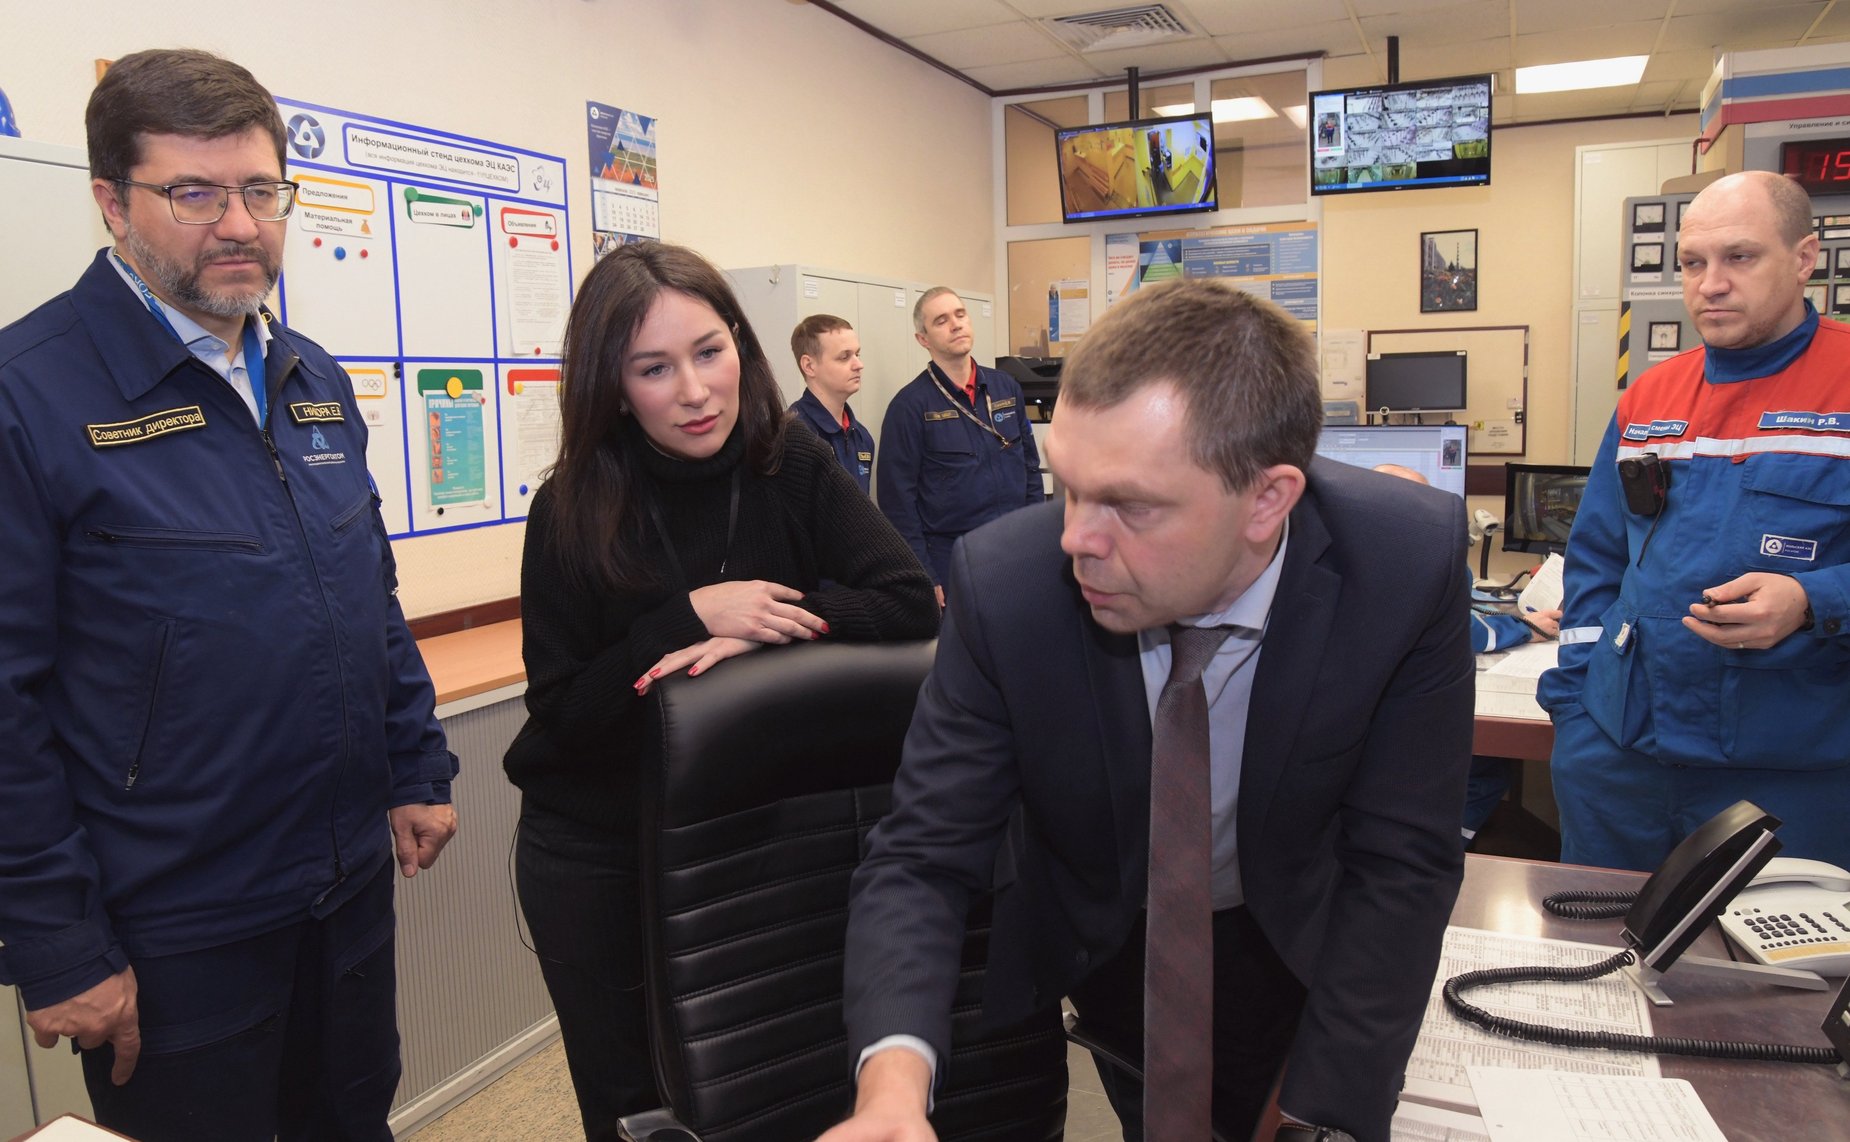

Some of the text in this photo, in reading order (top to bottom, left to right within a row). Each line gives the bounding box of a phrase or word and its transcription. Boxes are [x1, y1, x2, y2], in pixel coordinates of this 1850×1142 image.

[1789, 121, 1833, 129] Управление
[351, 134, 516, 173] Информационный стенд цехкома ЭЦ КАЭС
[302, 187, 348, 200] Предложения
[304, 211, 353, 224] Материальная
[316, 223, 343, 232] помощь
[92, 412, 201, 441] Советник директора
[1775, 415, 1815, 425] Шакин
